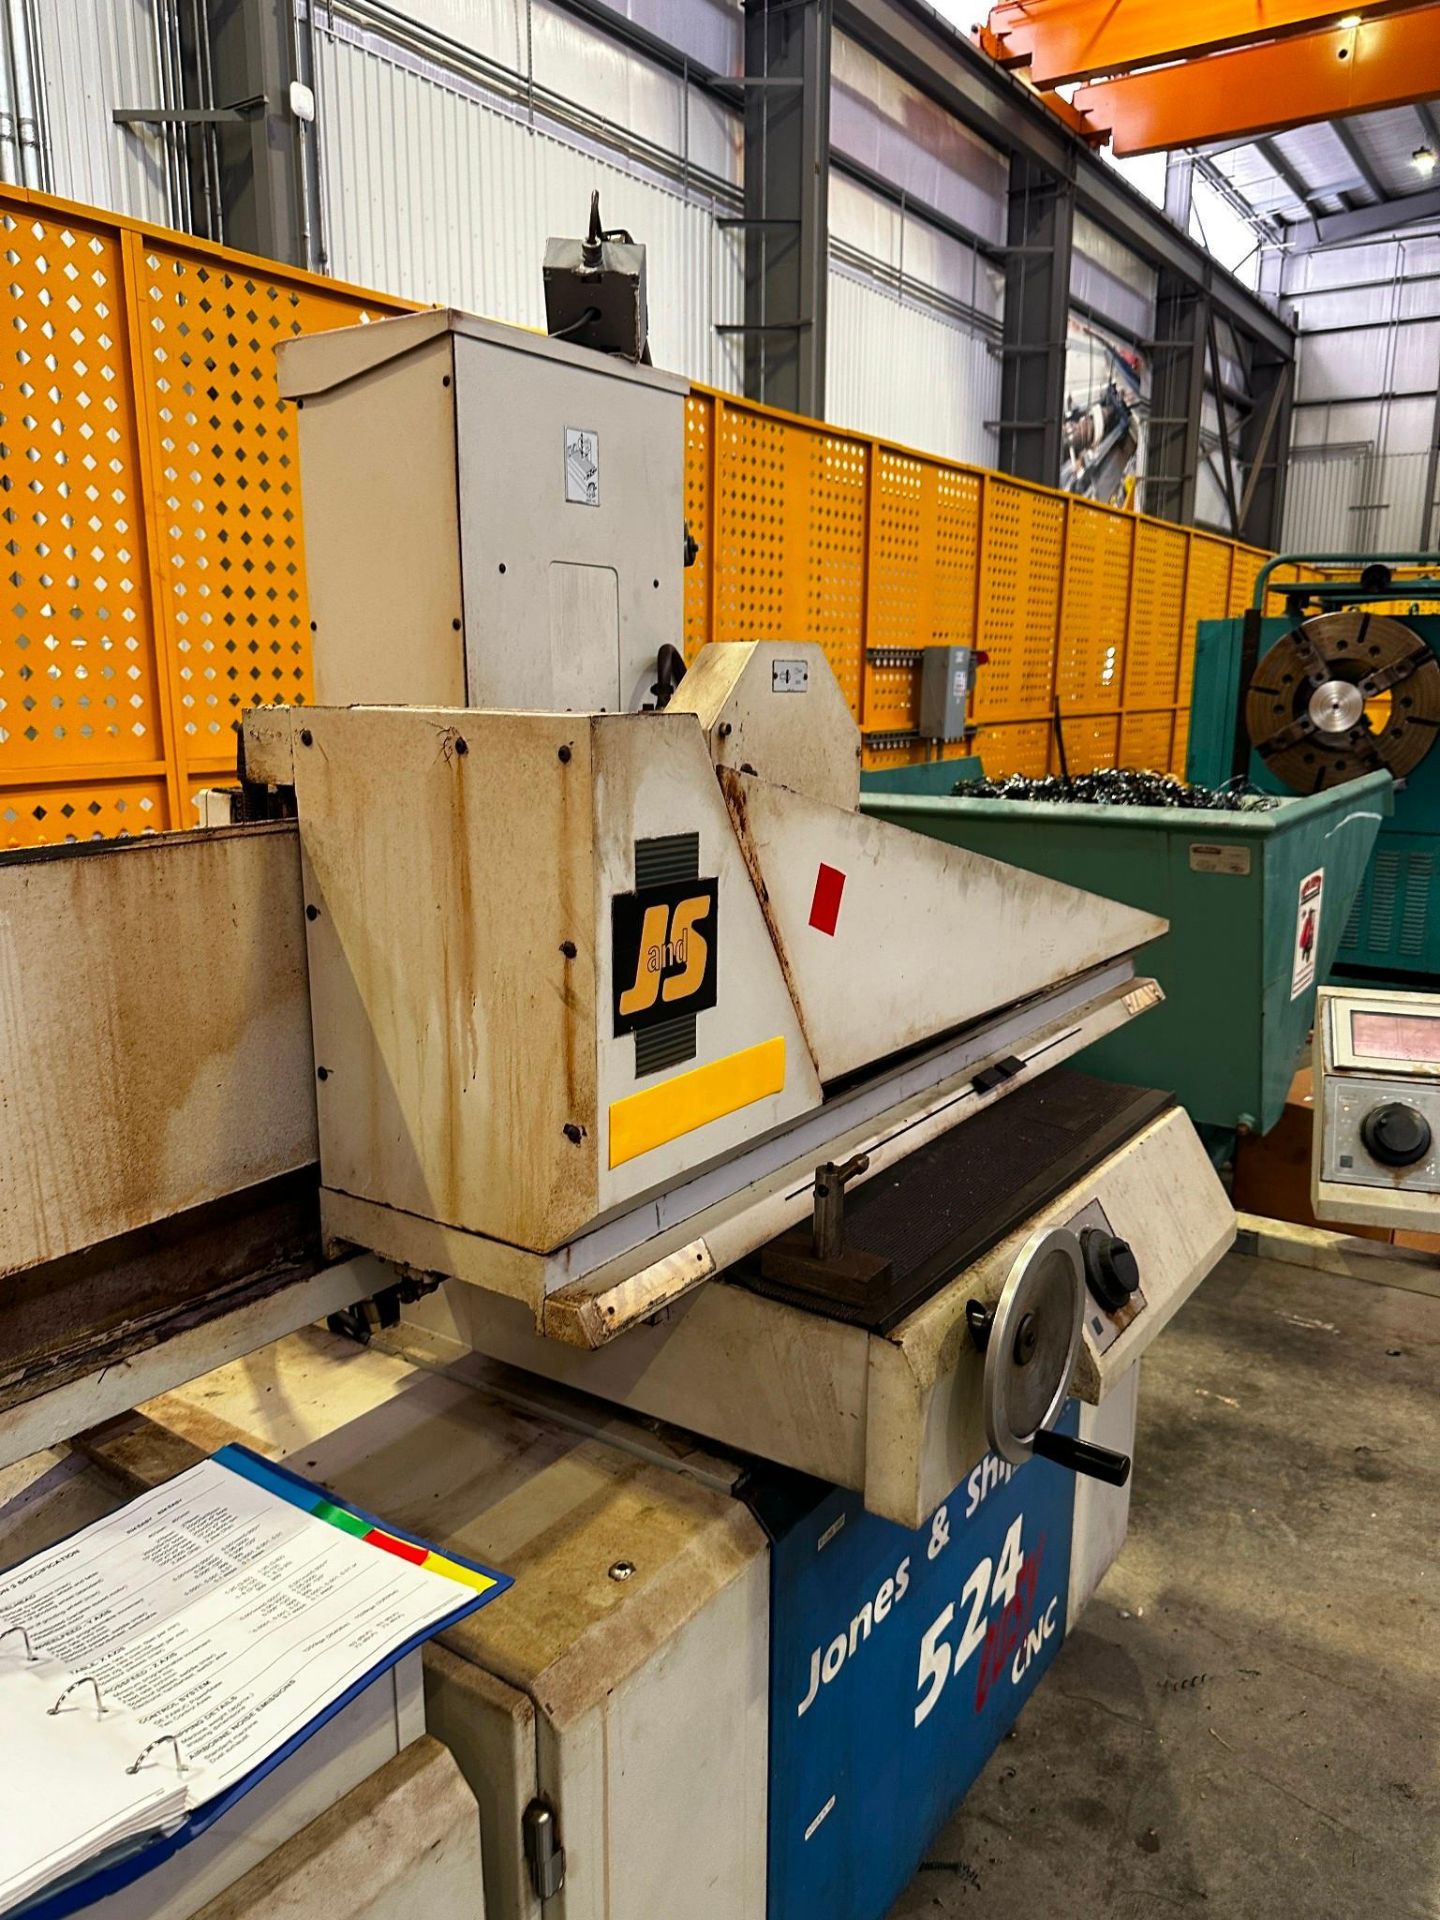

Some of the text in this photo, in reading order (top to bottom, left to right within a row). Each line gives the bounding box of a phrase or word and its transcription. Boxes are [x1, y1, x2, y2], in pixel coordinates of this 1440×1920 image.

[17, 1550, 80, 1585] SPECIFICATION
[94, 1610, 111, 1621] AXIS
[797, 1555, 911, 1718] Jones
[926, 1505, 951, 1561] &
[914, 1513, 1025, 1729] 524
[108, 1647, 125, 1658] AXIS
[160, 1653, 177, 1664] AXIS
[1011, 1595, 1059, 1686] CNC
[139, 1680, 211, 1724] CONTROL SYSTEM
[189, 1680, 294, 1760] AIRBORNE NOISE EMISSIONS
[204, 1696, 237, 1720] DETAILS
